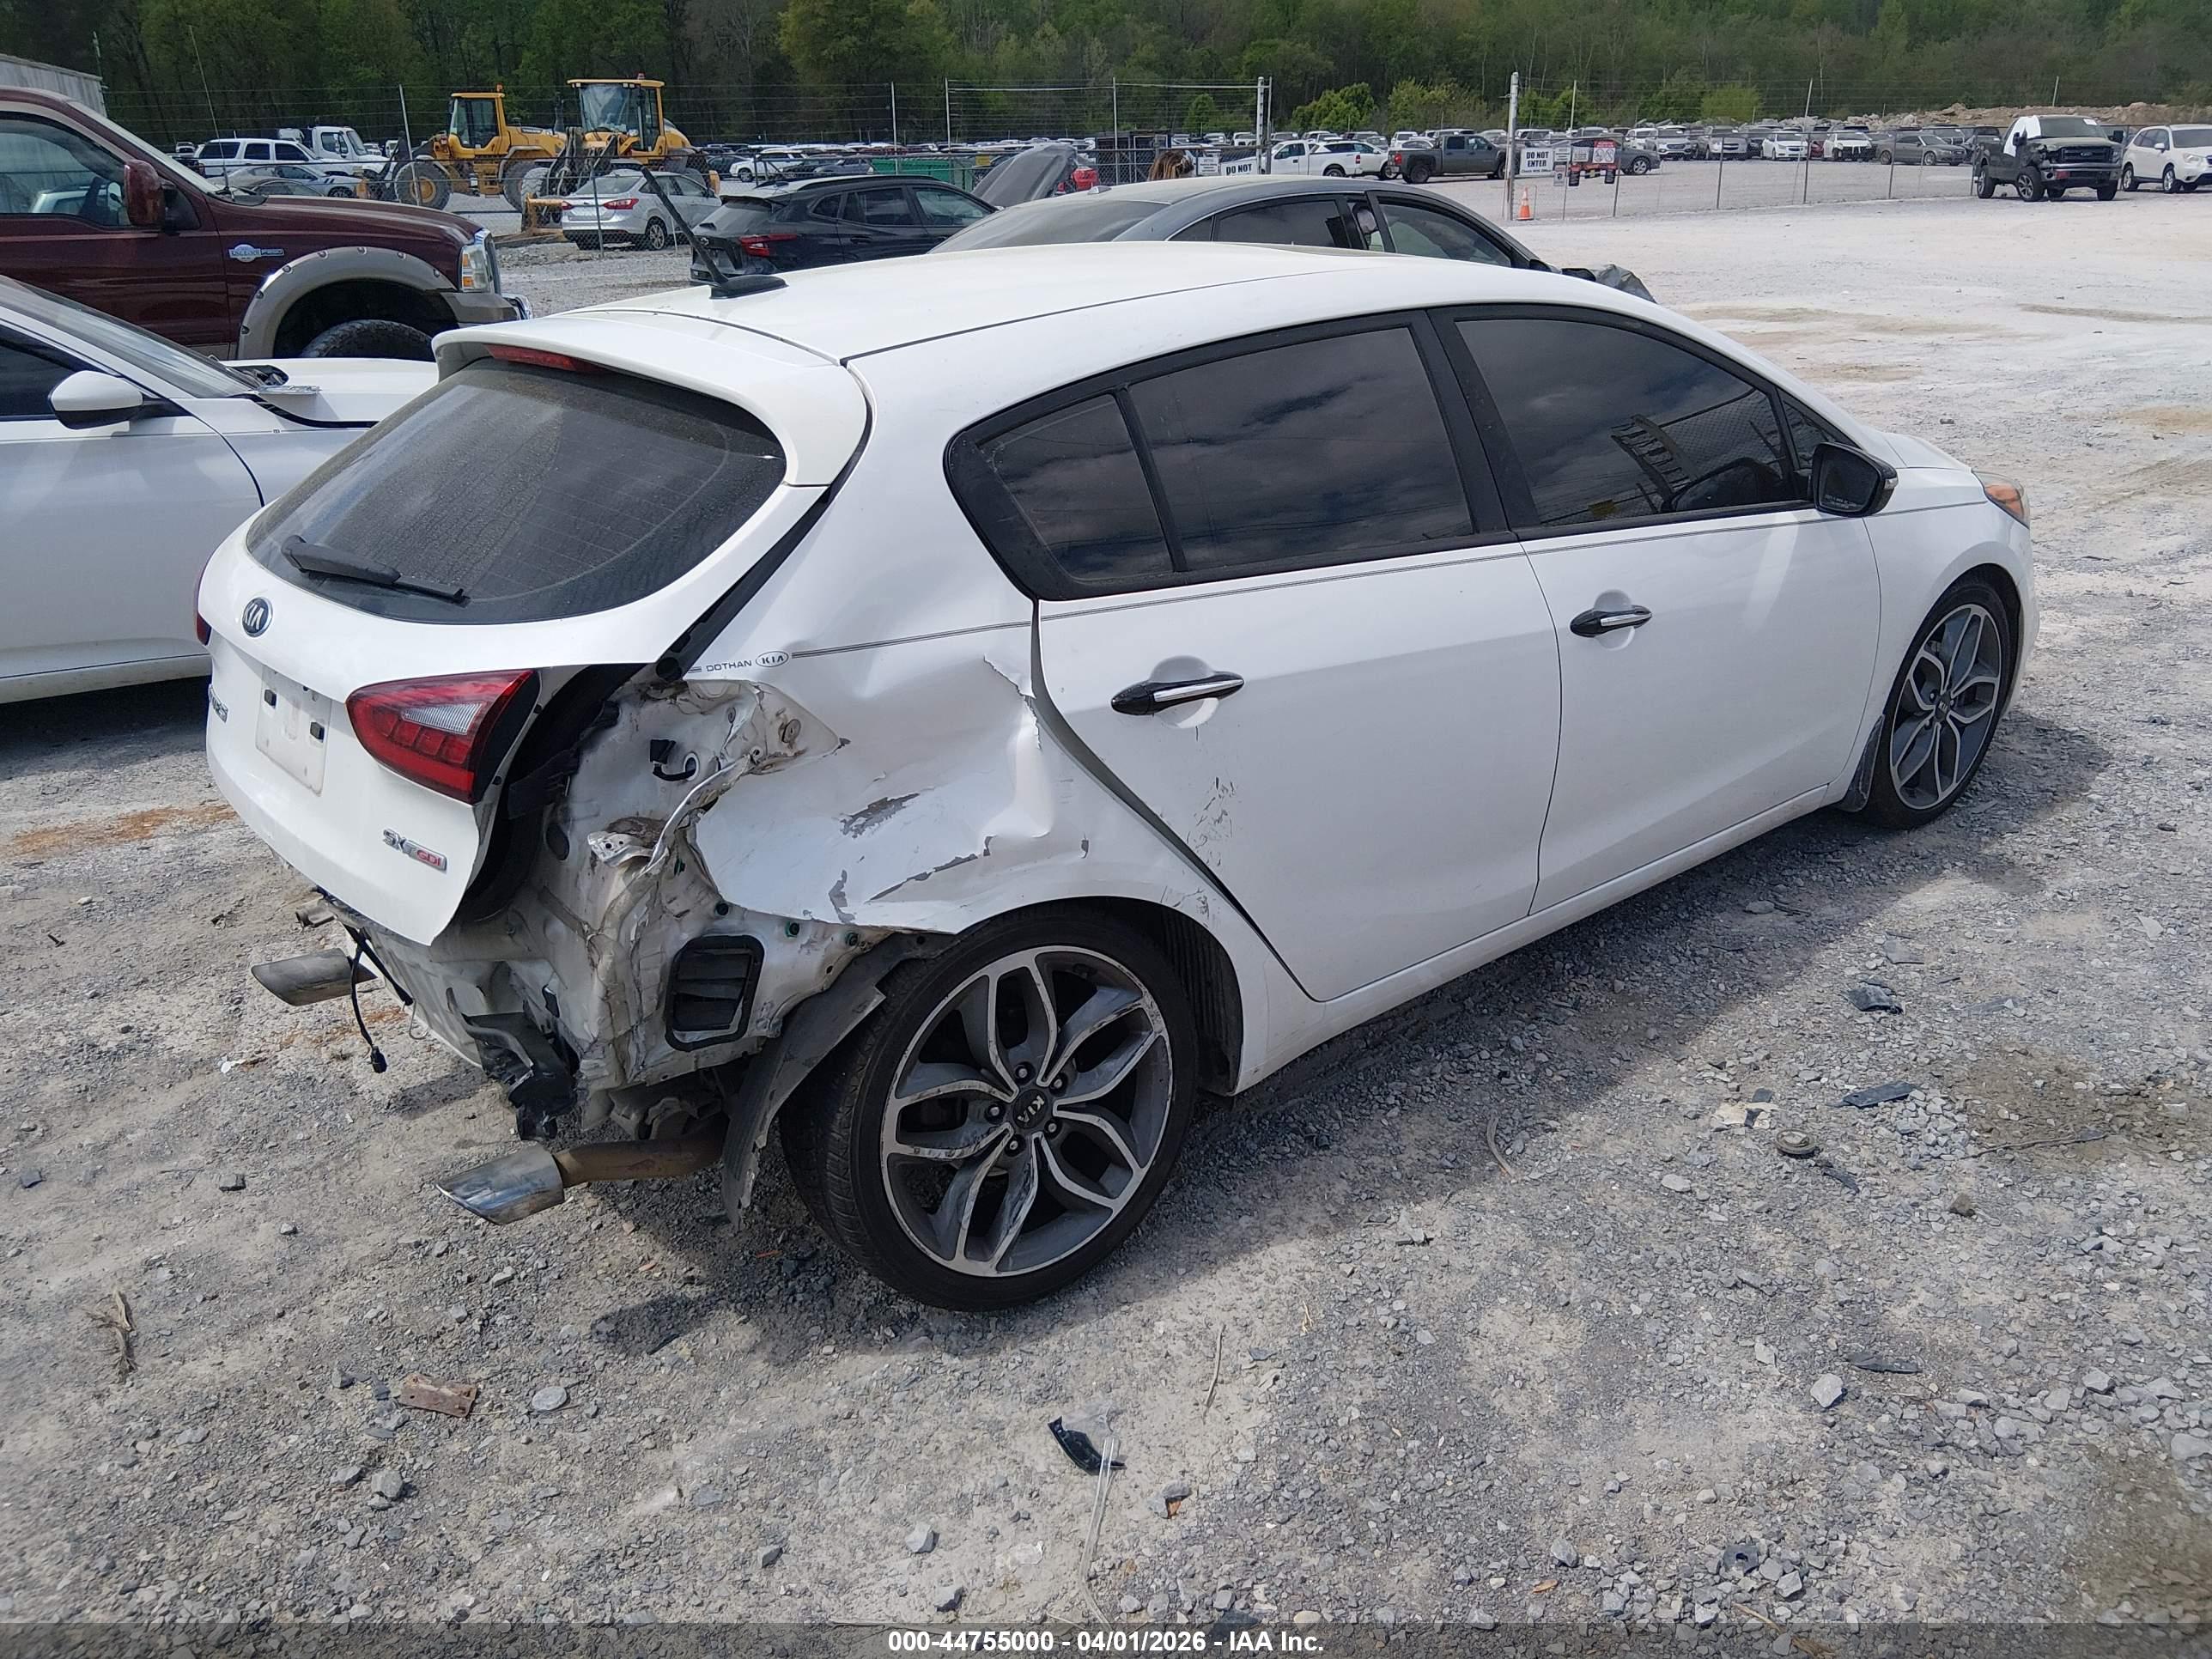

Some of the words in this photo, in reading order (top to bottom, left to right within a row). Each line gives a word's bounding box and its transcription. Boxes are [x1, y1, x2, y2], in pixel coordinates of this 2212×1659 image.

[1226, 166, 1237, 176] DO
[1237, 163, 1253, 173] NOT
[706, 659, 752, 672] DOTHAN
[762, 655, 785, 665] KIA
[1017, 1095, 1045, 1123] KIA
